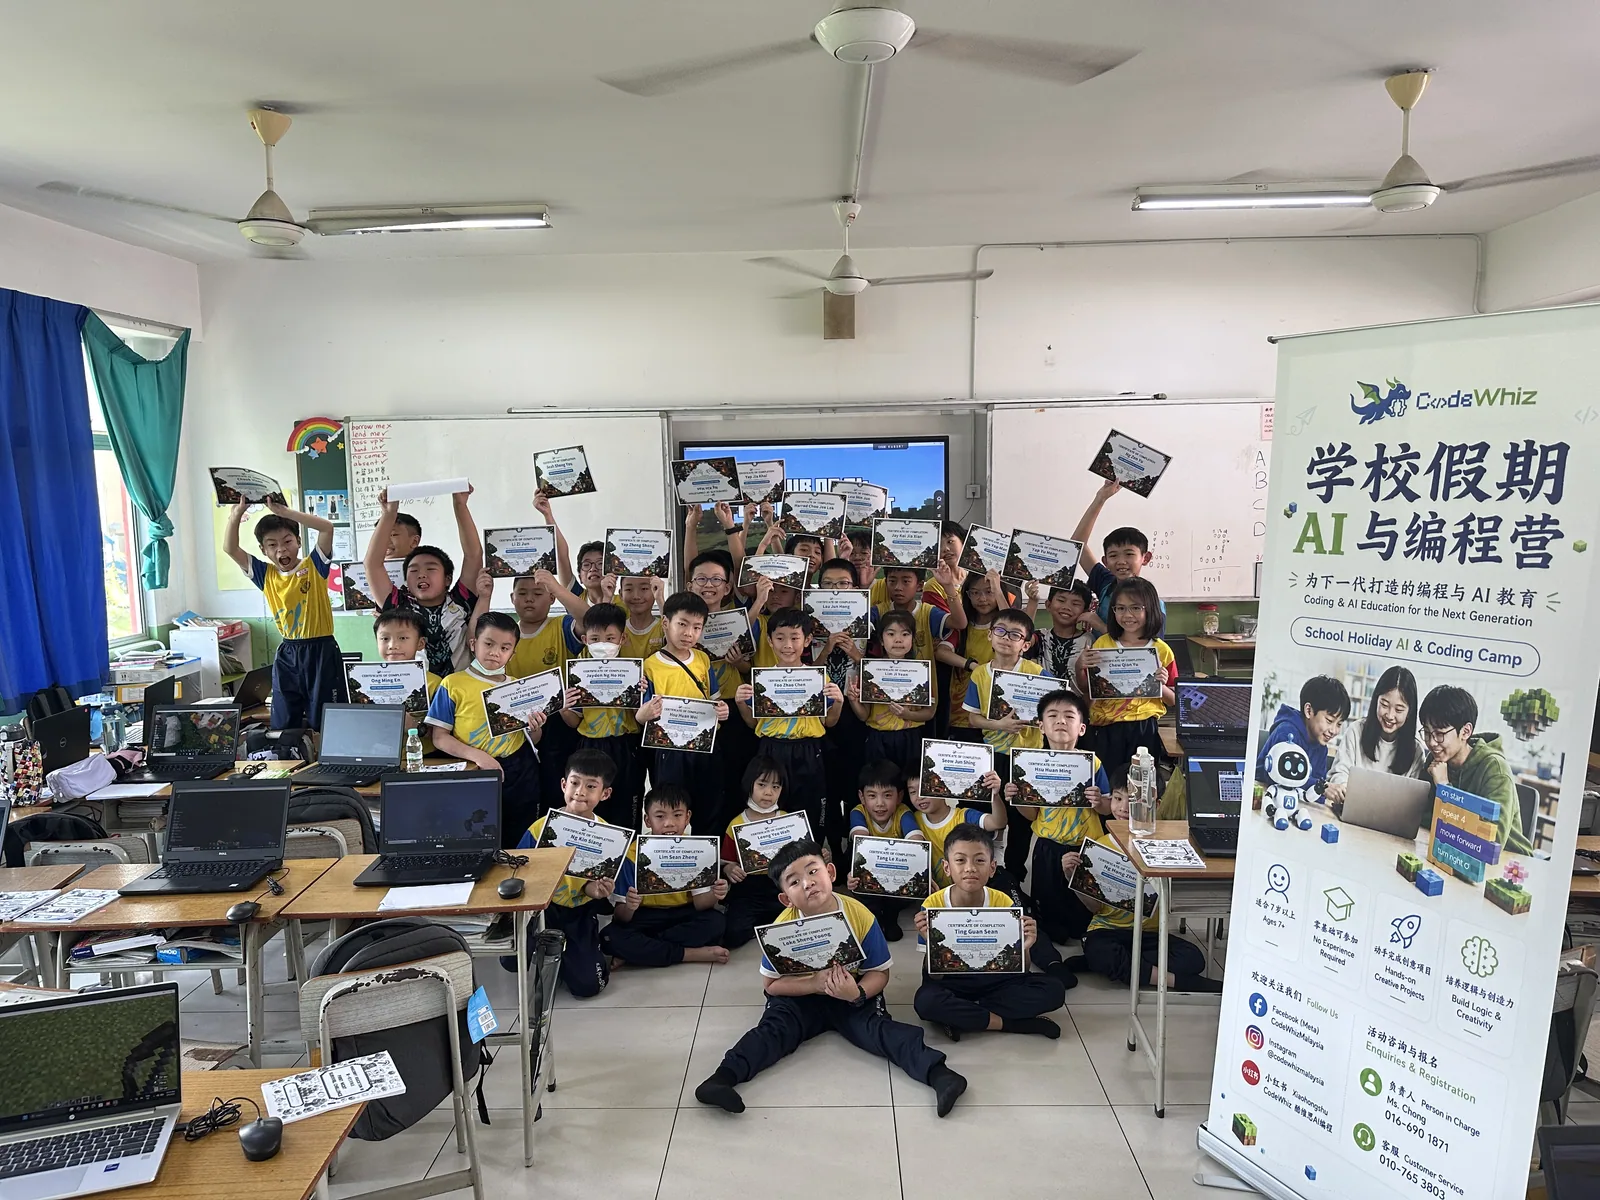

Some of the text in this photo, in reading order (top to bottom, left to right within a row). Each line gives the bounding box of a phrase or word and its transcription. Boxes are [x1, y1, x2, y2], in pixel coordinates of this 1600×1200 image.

[352, 422, 373, 430] borrow
[1255, 451, 1265, 466] A
[1306, 440, 1570, 505] 学校假期
[1256, 471, 1267, 489] B
[1293, 511, 1564, 569] AI 与编程营
[1305, 572, 1537, 608] 为下一代打造的编程与 AI 教育
[1304, 595, 1532, 627] Coding & AI Education for the Next Generation
[1305, 626, 1522, 668] School Holiday AI & Coding Camp
[1450, 792, 1464, 803] start
[1441, 808, 1460, 821] repeat
[1440, 828, 1482, 853] move forward
[1438, 847, 1463, 866] turn right
[1256, 898, 1296, 920] 适合7岁以上
[1263, 915, 1285, 928] Ages 7+
[1313, 935, 1355, 958] No Experience
[1314, 920, 1358, 944] 零基础可参加
[1320, 949, 1346, 966] Required
[1374, 945, 1431, 976] 动手完成创意项目
[1374, 973, 1425, 1001] Creative Projects
[1385, 965, 1416, 985] Hands-on
[1251, 971, 1339, 1019] 欢迎关注我们 Follow Us
[1445, 975, 1514, 1008] 培养逻辑与创造力
[1272, 1005, 1320, 1035] Facebook (Meta)
[1452, 994, 1502, 1021] Build Logic &
[1456, 1009, 1493, 1032] Creativity
[1271, 1017, 1324, 1050] CodeWhizMalaysia
[1368, 1025, 1438, 1069] 活动咨询与报名
[1268, 1038, 1296, 1059] Instagram
[1243, 1066, 1258, 1080] 小红书
[1268, 1050, 1324, 1086] @codewhizmalaysia
[1366, 1041, 1476, 1104] Enquiries & Registration
[1263, 1087, 1292, 1109] CodeWhiz
[1265, 1074, 1328, 1116] 小红书 Xiaohongshu
[1389, 1080, 1480, 1137] 负责人 Person in Charge
[1387, 1096, 1427, 1126] Ms. Chong
[1385, 1110, 1449, 1153] 016-690 1871
[1379, 1154, 1445, 1200] 010-765 3803
[1382, 1140, 1464, 1196] 客服 Customer Service
